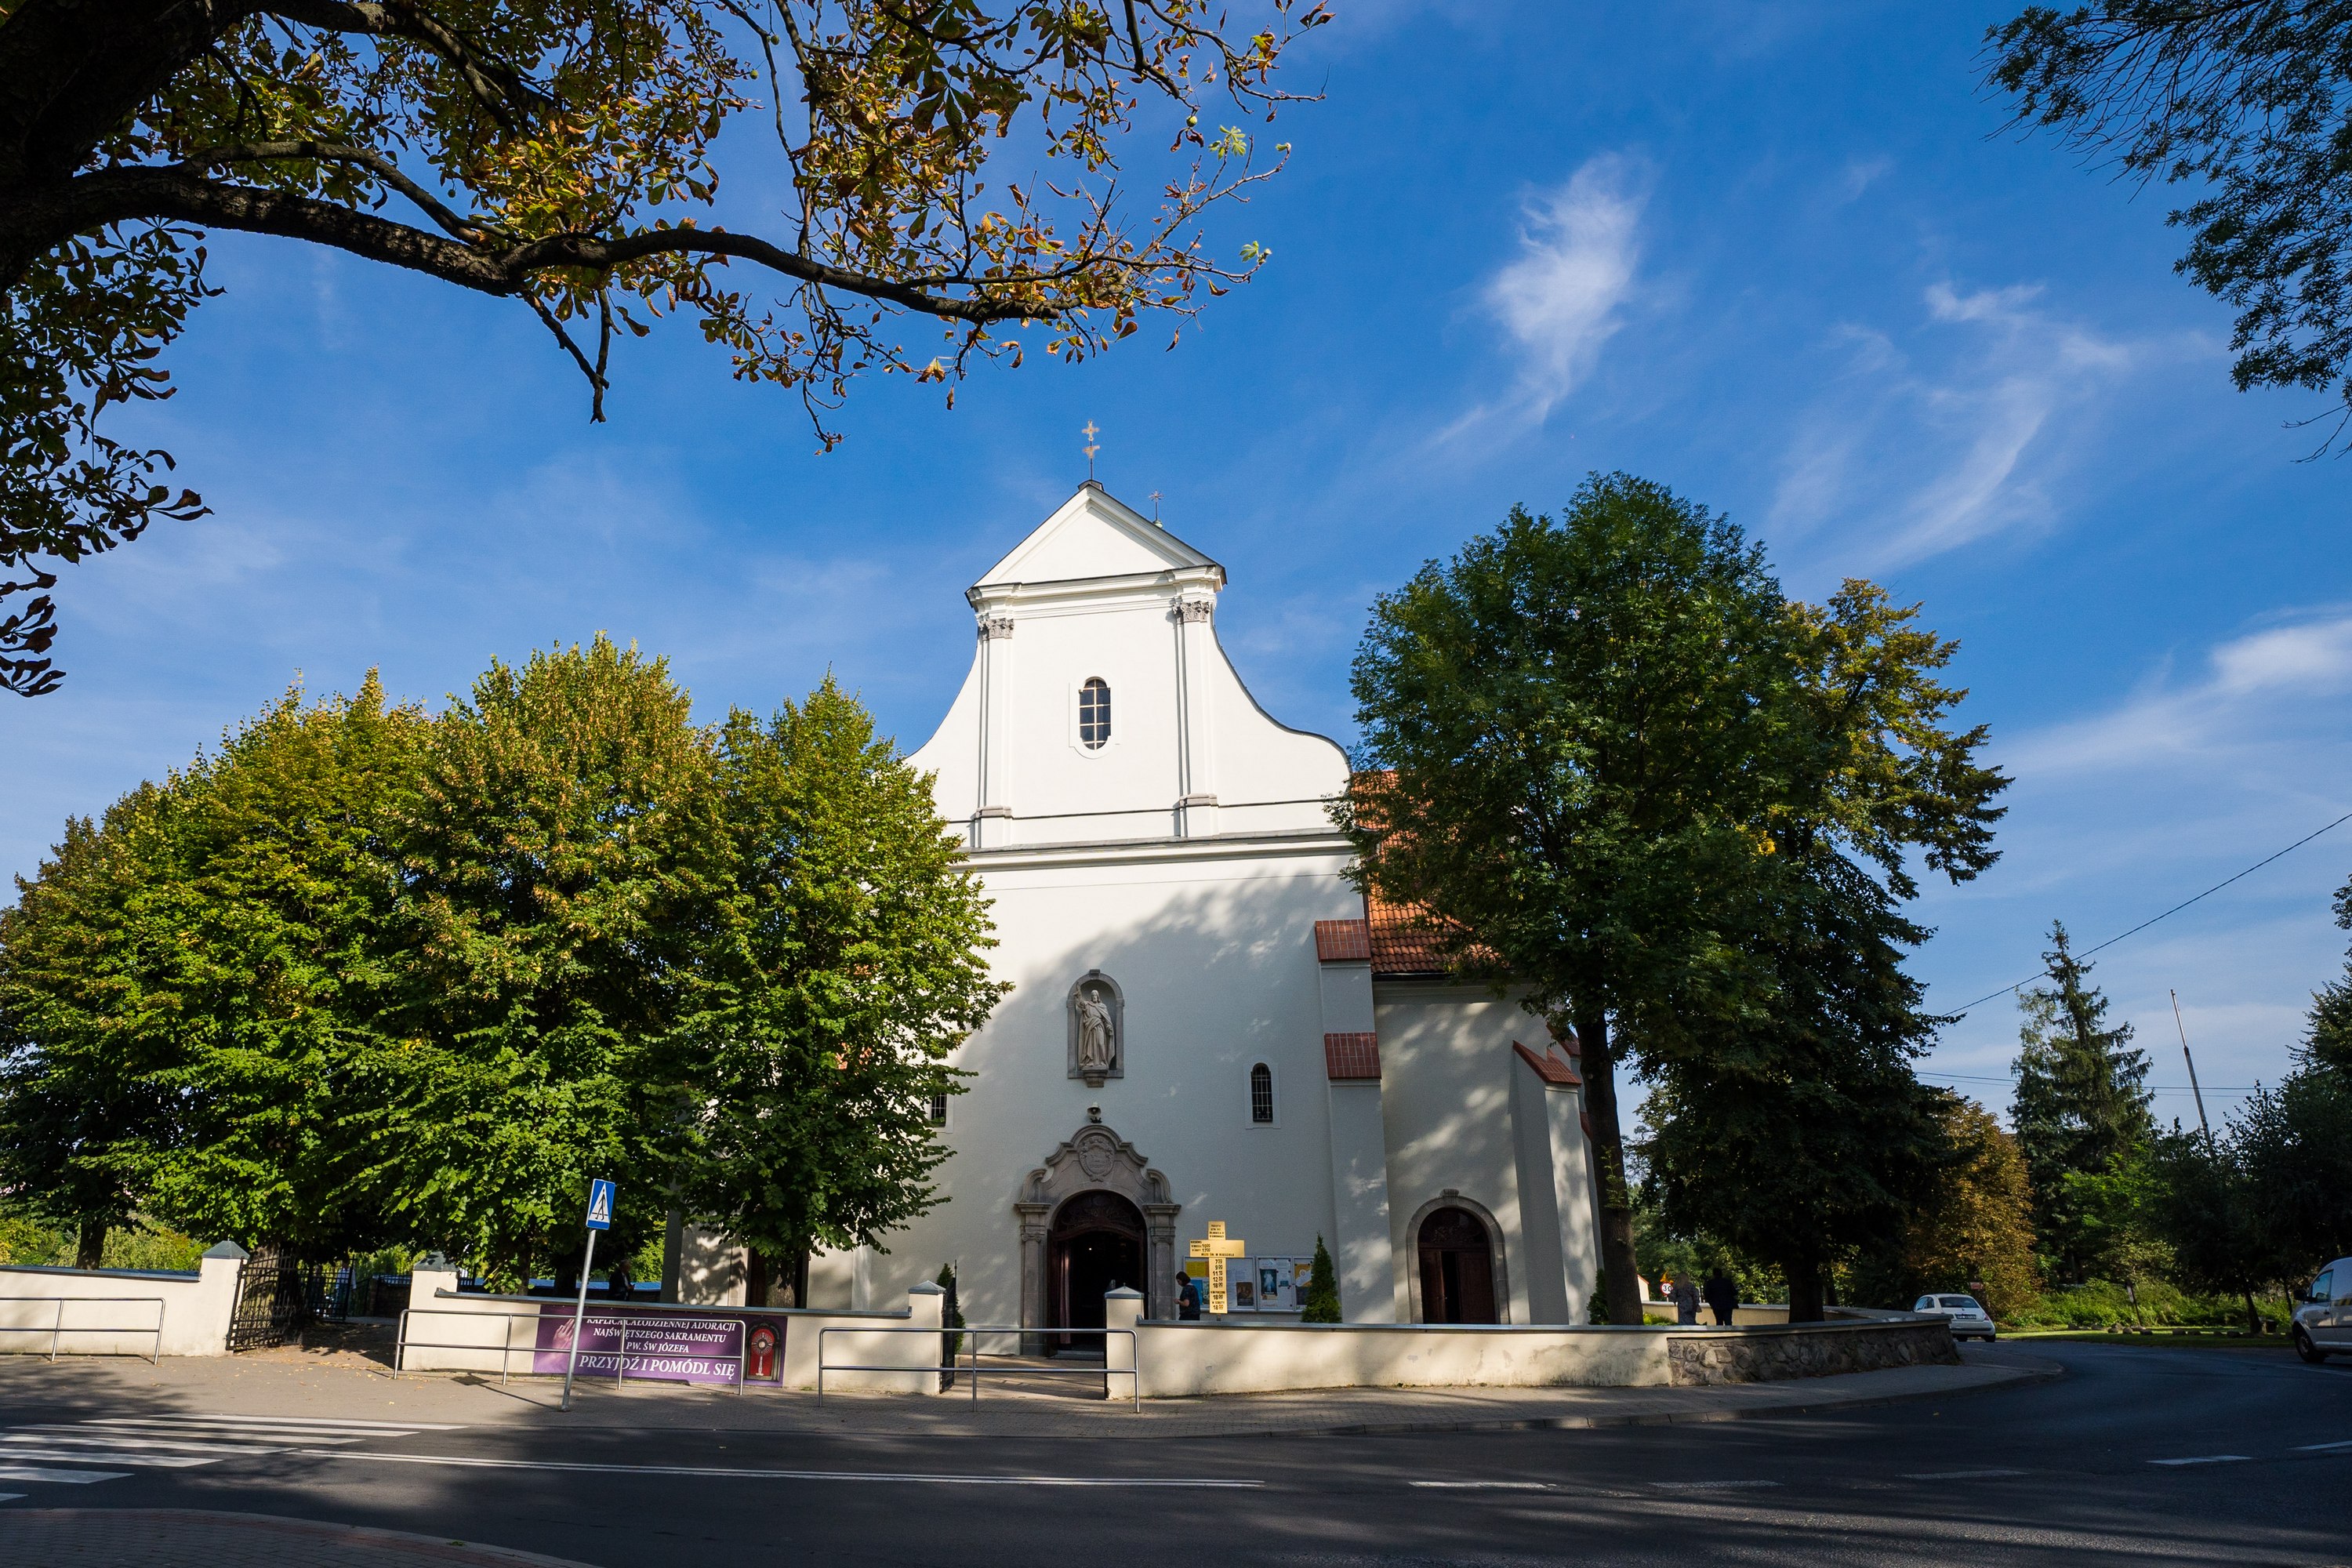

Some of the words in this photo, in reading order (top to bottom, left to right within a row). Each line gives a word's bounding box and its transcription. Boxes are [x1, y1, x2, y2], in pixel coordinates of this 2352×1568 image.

[691, 1322, 736, 1332] ADORACJI
[593, 1327, 663, 1340] NAJŚWĘTSZEGO
[664, 1331, 727, 1343] SAKRAMENTU
[626, 1341, 641, 1350] PW.
[643, 1341, 658, 1351] ŚW
[657, 1342, 689, 1353] JÓZEFA
[579, 1355, 640, 1371] PRZYJDŹ
[641, 1359, 649, 1371] I
[649, 1359, 710, 1375] POMÓDL
[713, 1363, 736, 1380] SIĘ
